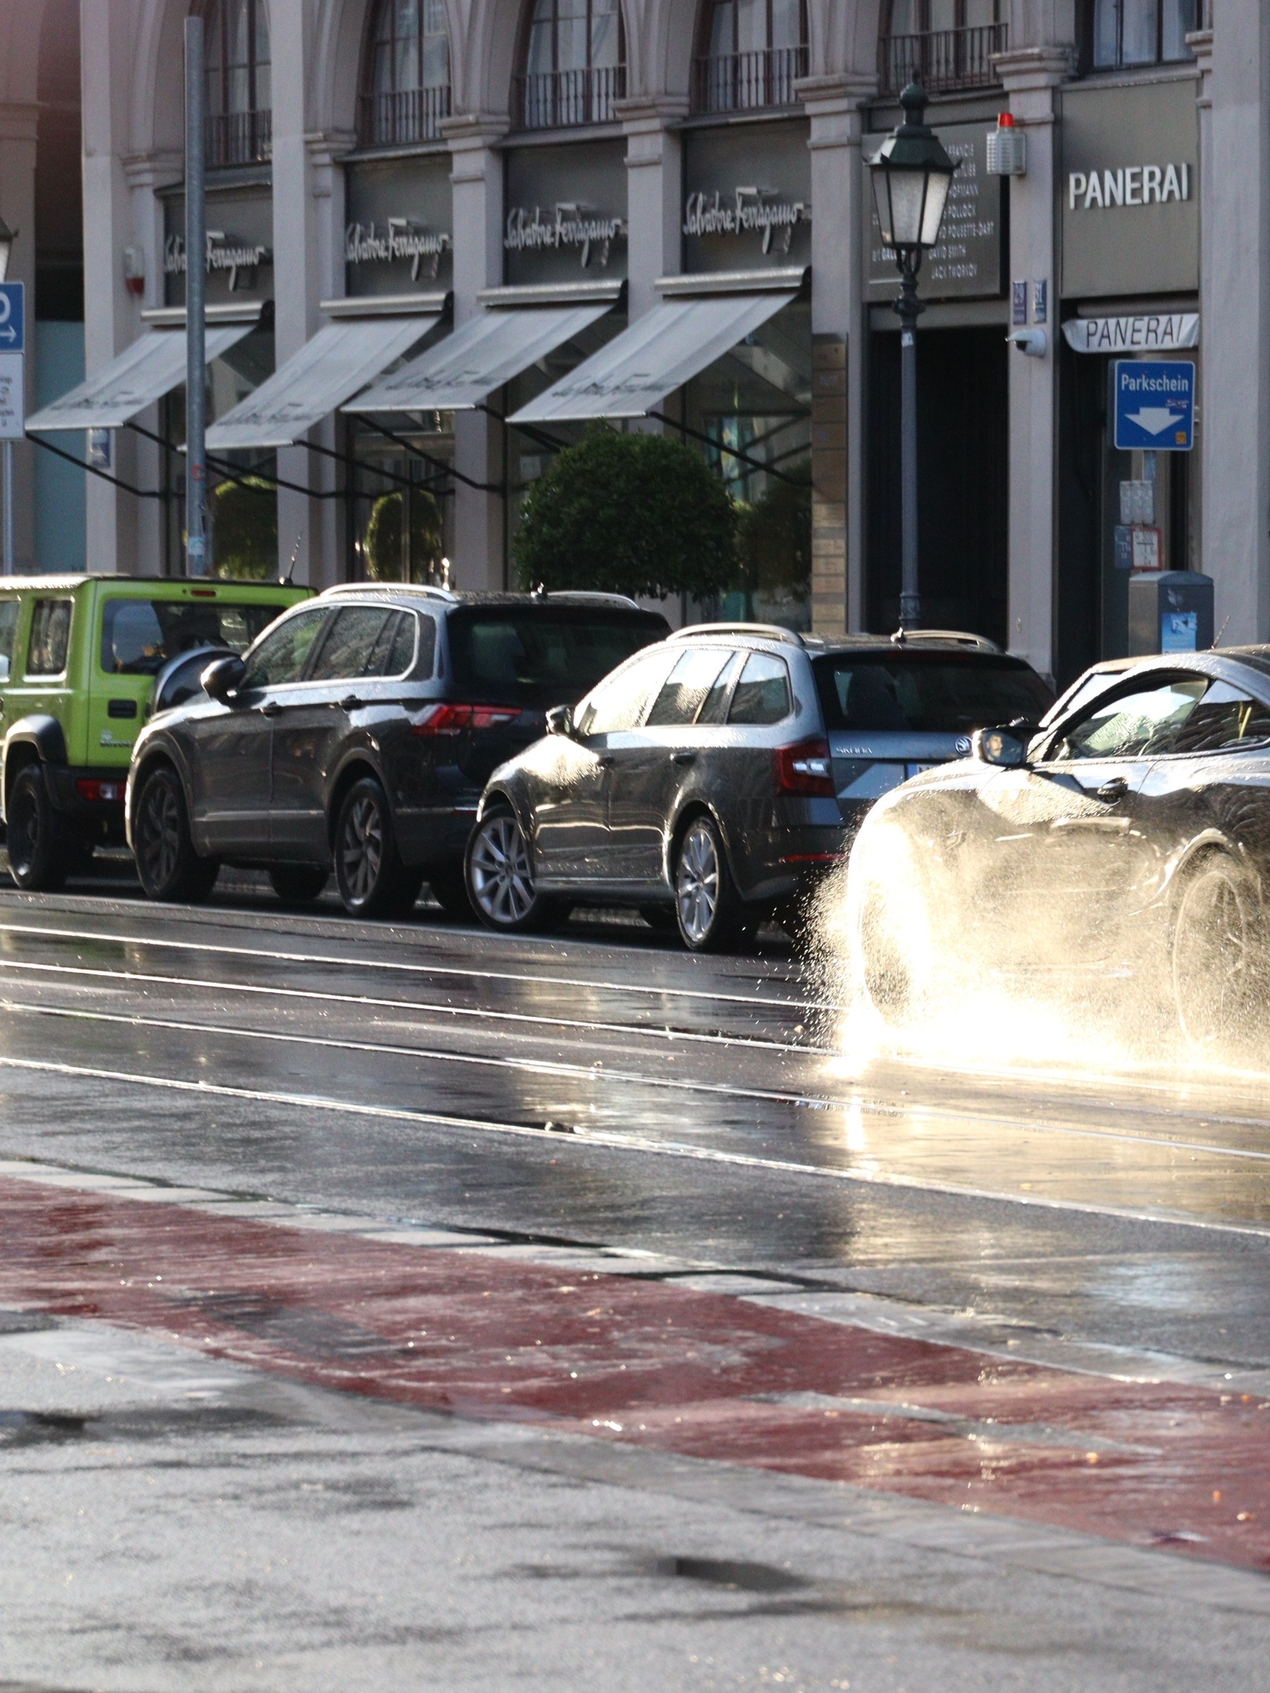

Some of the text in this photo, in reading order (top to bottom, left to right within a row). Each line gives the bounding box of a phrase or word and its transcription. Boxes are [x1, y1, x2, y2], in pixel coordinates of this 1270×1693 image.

[1069, 163, 1189, 210] PANERAI
[1086, 315, 1183, 348] PANERAI
[1121, 373, 1189, 392] Parkschein
